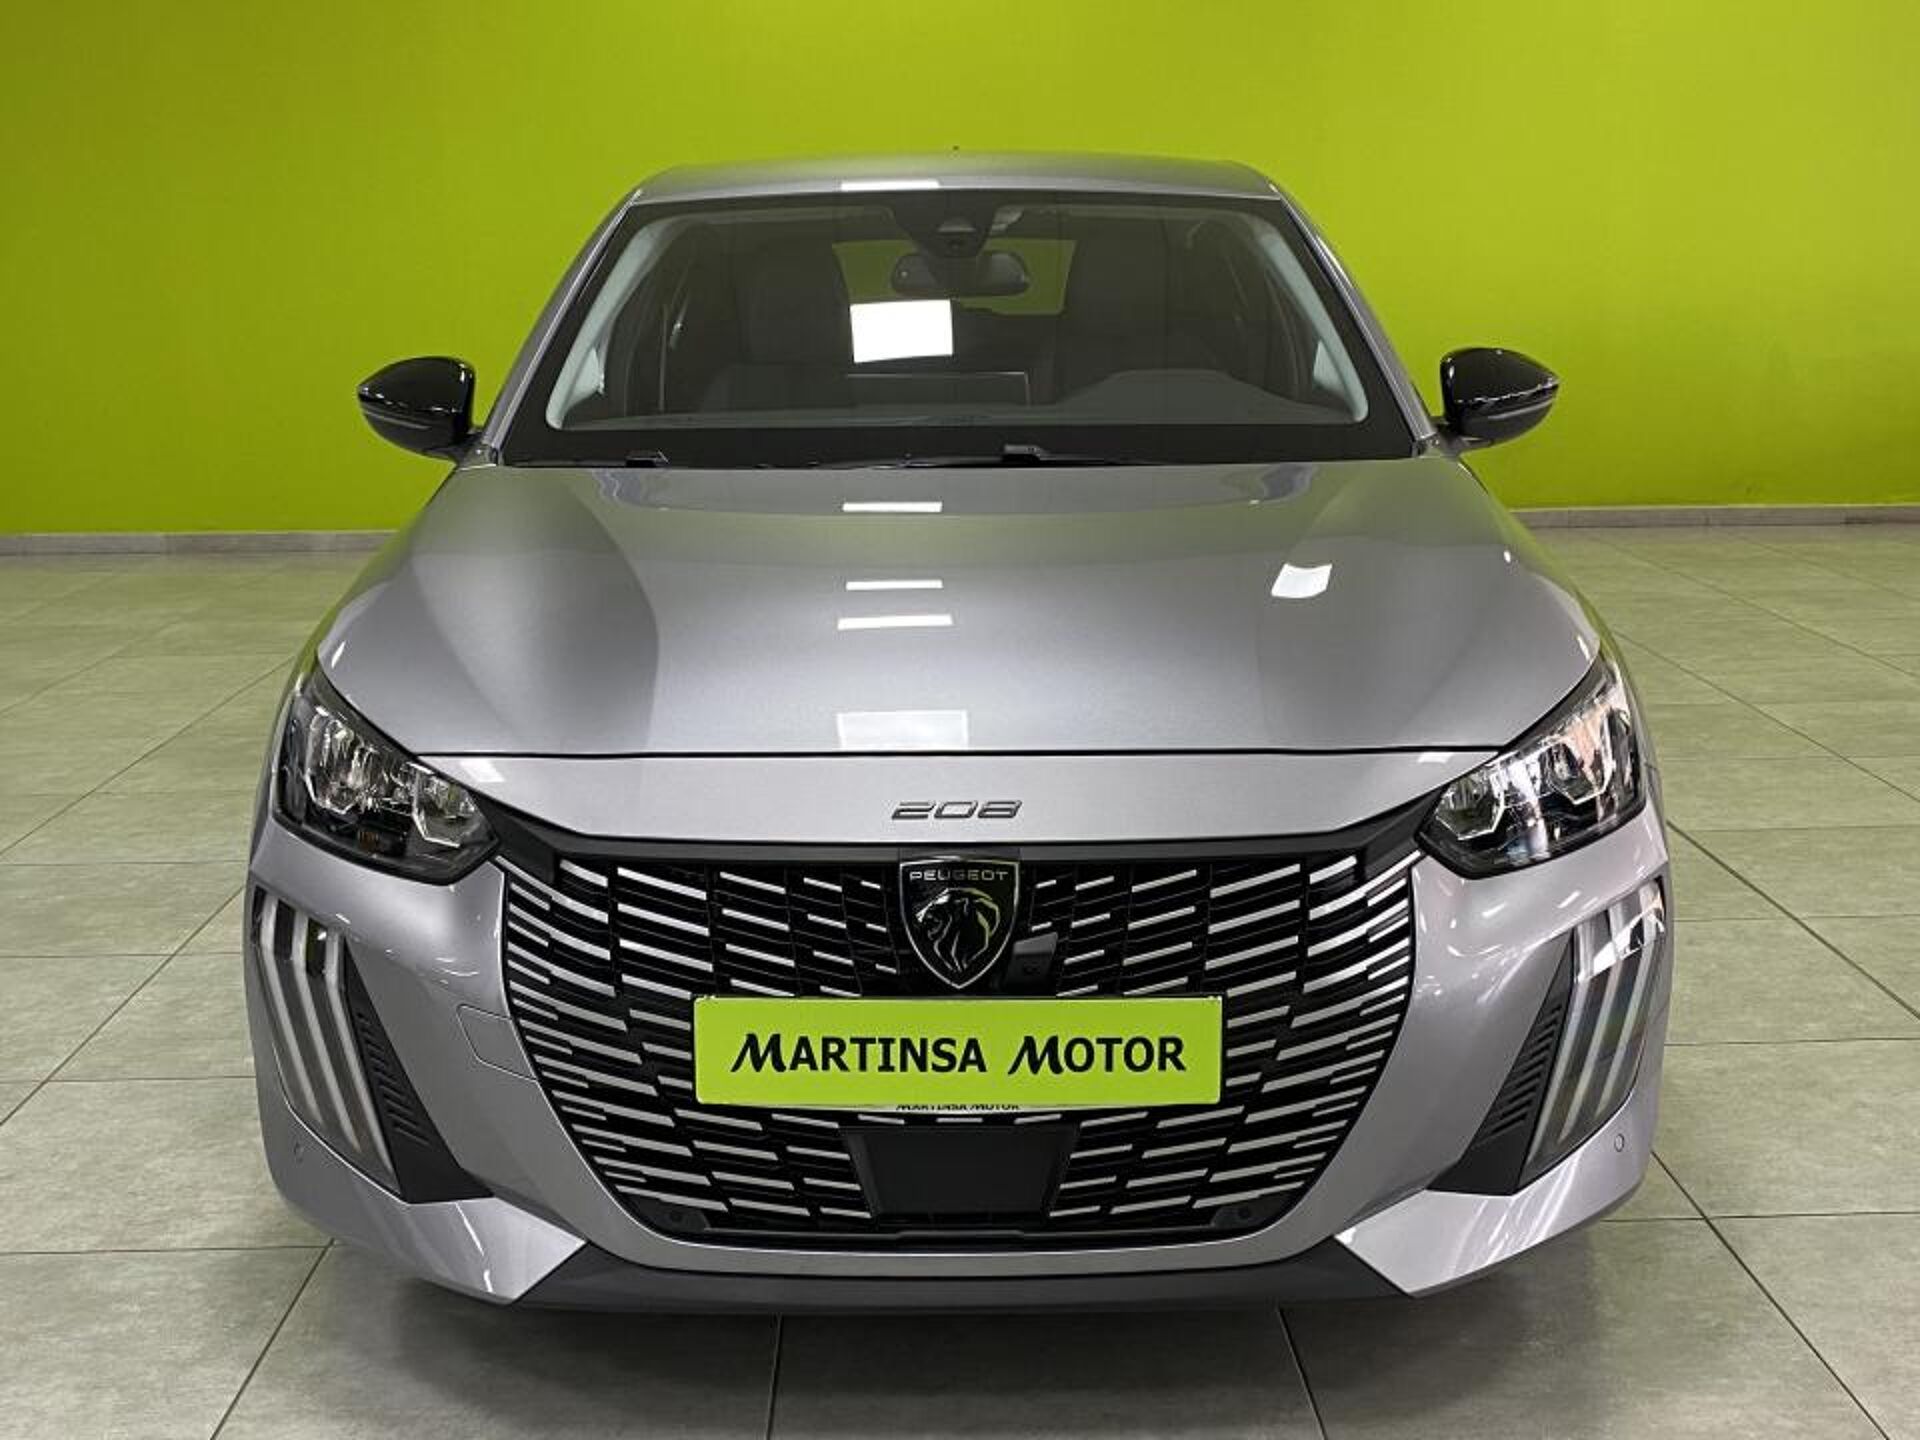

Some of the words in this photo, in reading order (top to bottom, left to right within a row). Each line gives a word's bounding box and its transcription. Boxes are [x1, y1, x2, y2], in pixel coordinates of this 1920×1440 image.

[891, 801, 1022, 820] 208
[909, 869, 1009, 881] PEUGEOT
[730, 1033, 988, 1073] MARTINSA
[1008, 1034, 1187, 1075] MOTOR
